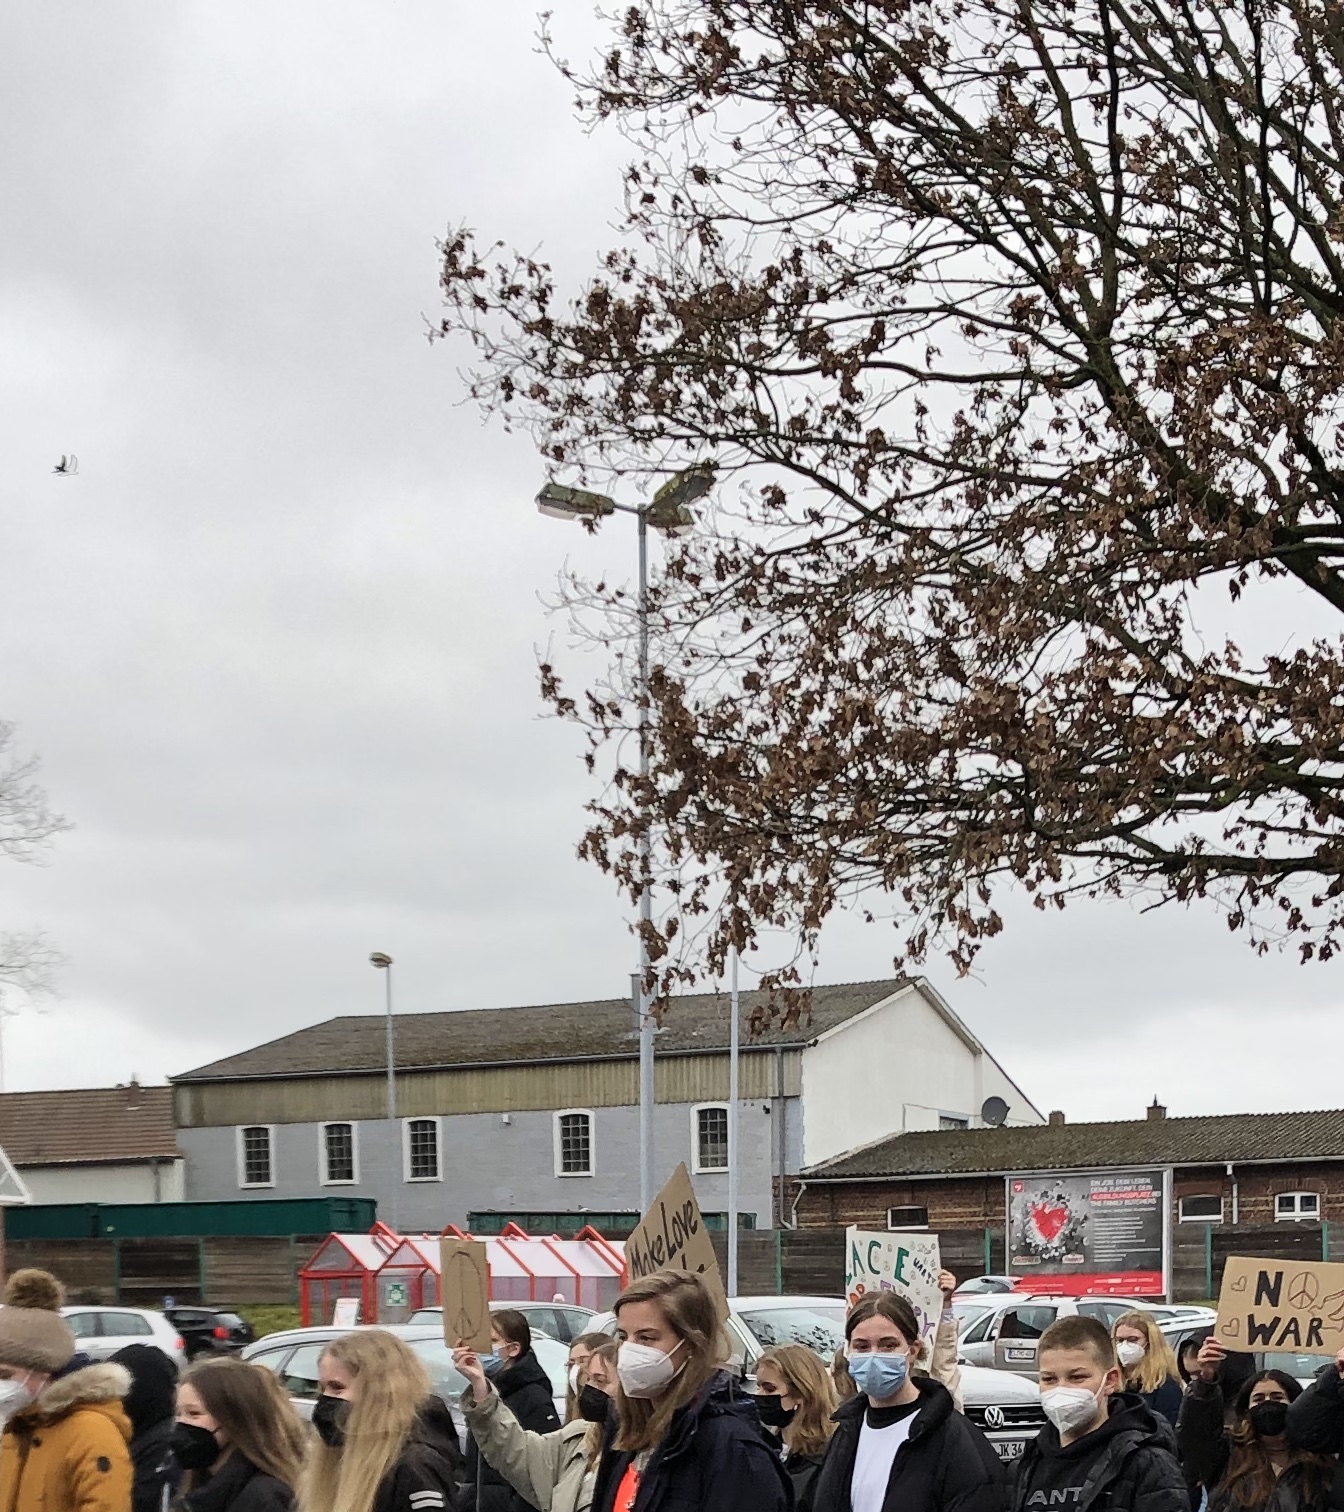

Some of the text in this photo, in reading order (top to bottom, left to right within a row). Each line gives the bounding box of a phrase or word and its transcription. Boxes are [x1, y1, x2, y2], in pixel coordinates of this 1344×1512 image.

[661, 1200, 698, 1261] Love
[846, 1240, 910, 1287] ACE
[1248, 1313, 1324, 1347] WAR
[1027, 1486, 1083, 1506] ANT
